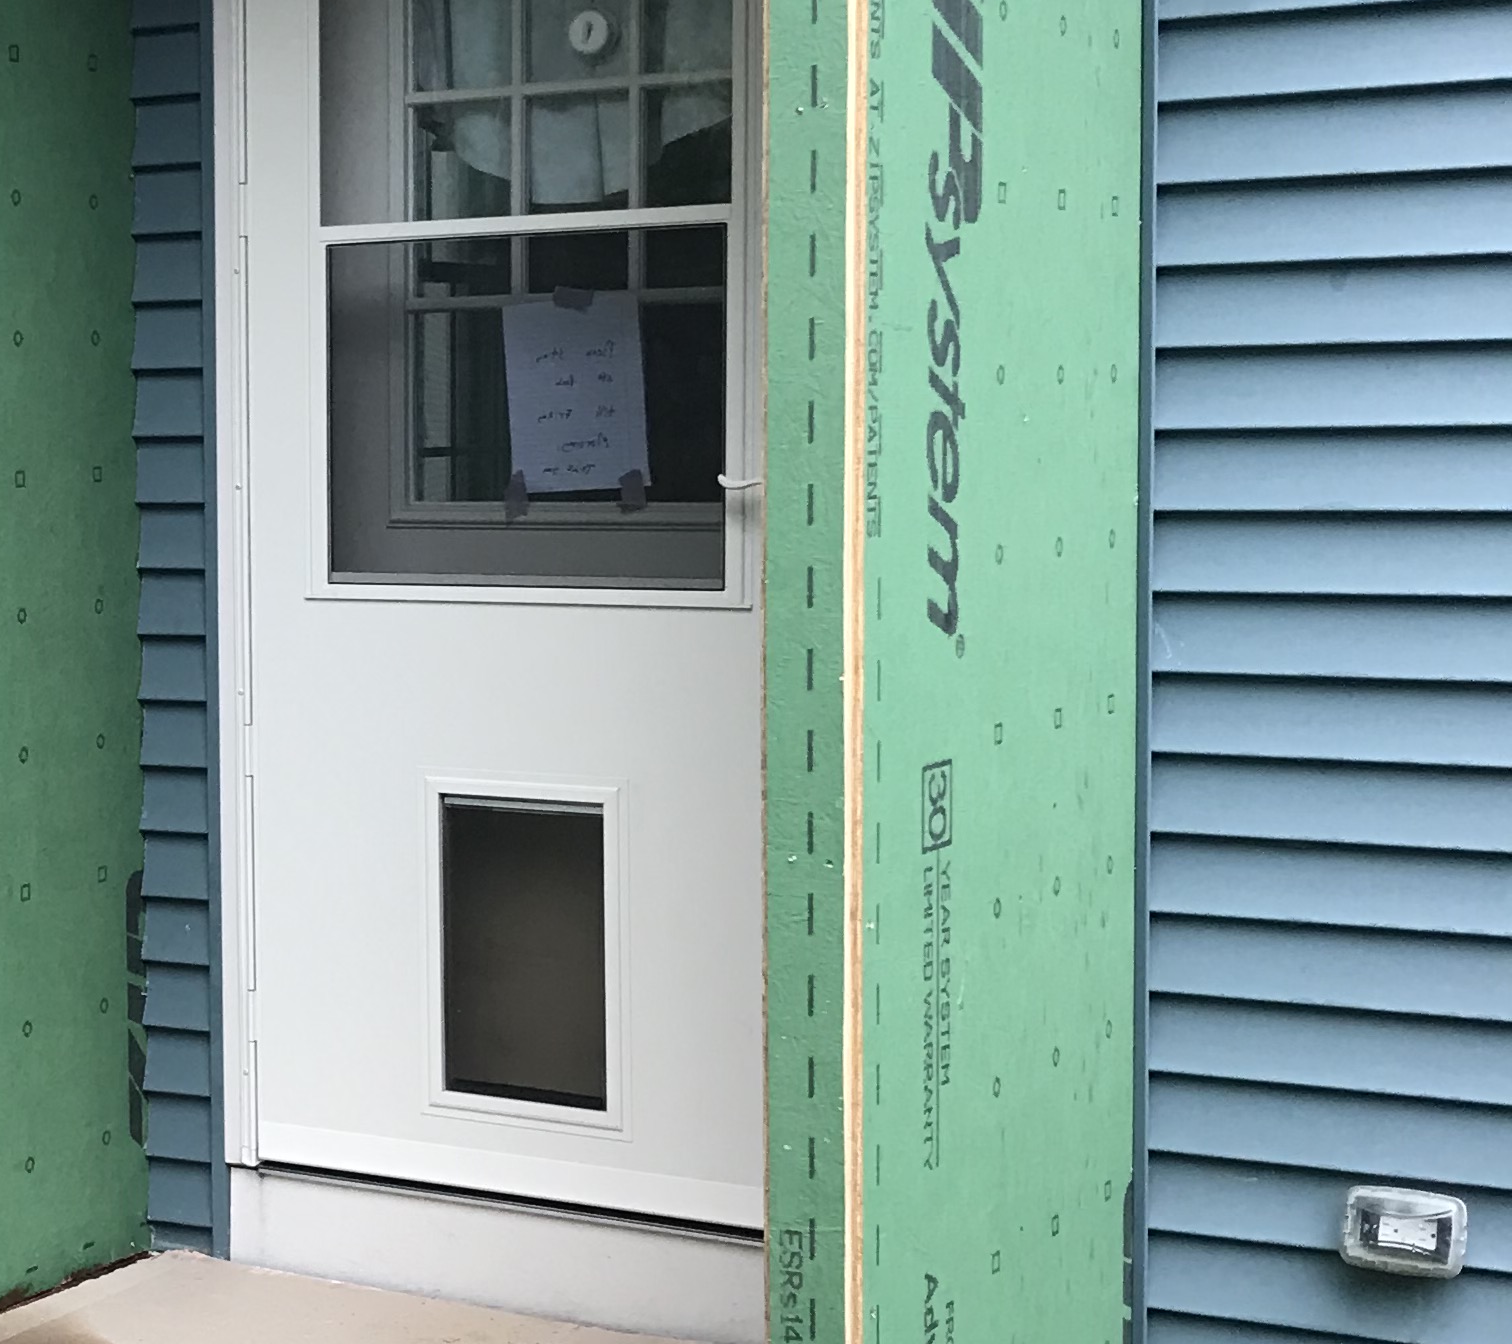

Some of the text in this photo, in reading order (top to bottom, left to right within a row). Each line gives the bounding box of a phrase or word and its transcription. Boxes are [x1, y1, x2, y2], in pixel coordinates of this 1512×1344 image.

[869, 77, 883, 120] AT
[928, 771, 948, 843] 30
[923, 865, 935, 1171] LIMITED WARRANTY
[940, 858, 951, 1086] YEAR SYSTEM
